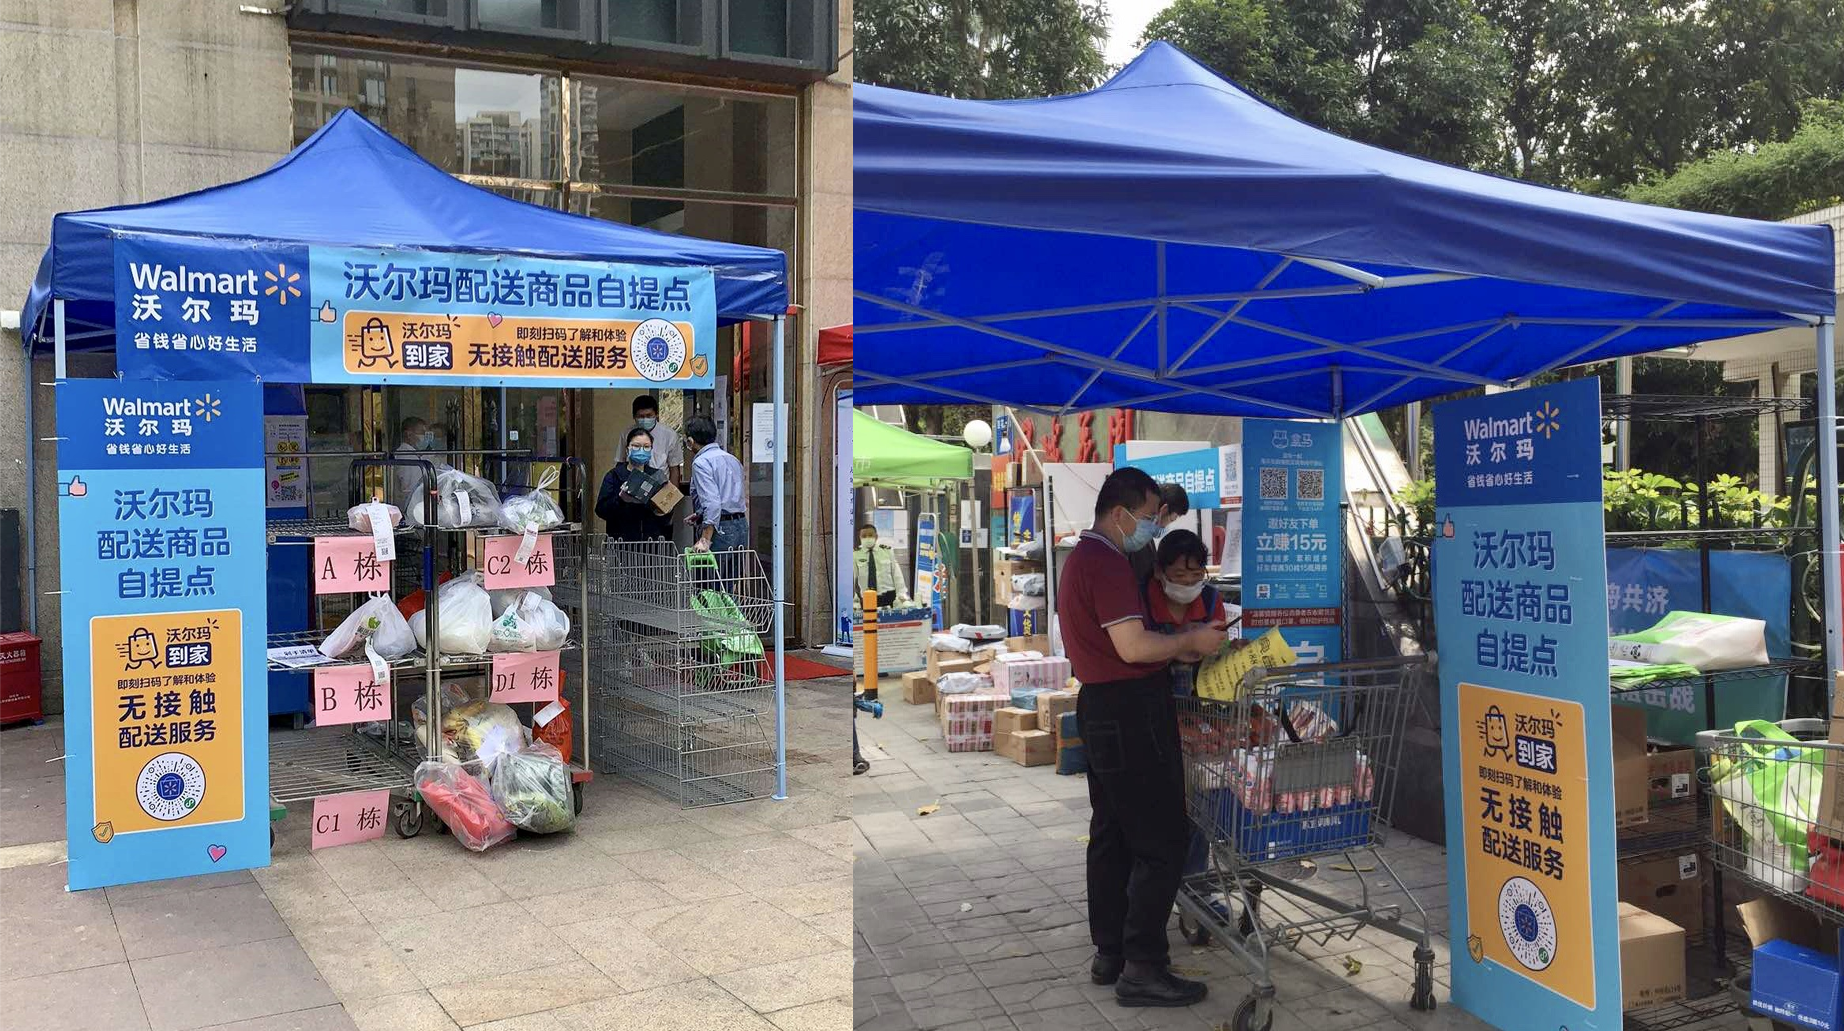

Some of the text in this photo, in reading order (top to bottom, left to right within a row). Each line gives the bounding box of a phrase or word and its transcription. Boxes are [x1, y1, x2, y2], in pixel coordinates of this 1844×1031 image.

[130, 262, 258, 296] Walmart
[343, 261, 692, 313] 沃尔玛配送商品自提点
[132, 294, 260, 326] 沃尔玛
[134, 332, 258, 353] 省钱省心好生活
[402, 322, 452, 340] 沃尔玛
[516, 326, 627, 342] 即刻扫码了解和体验
[404, 343, 452, 369] 到家
[468, 343, 629, 370] 无接触配送服务
[103, 397, 191, 417] Walmart
[104, 418, 193, 436] 沃尔玛
[1464, 411, 1533, 441] Walmart
[106, 443, 191, 456] 省钱省心好生活
[1466, 439, 1534, 465] 沃尔玛
[1467, 471, 1533, 488] 省钱省心好生活
[114, 489, 214, 521] 沃尔玛
[97, 527, 231, 561] 配送商品
[1256, 533, 1327, 551] 立赚15元
[1473, 529, 1555, 570] 沃尔玛
[321, 551, 383, 582] A 栋
[487, 550, 549, 576] C2 栋
[118, 566, 217, 599] 自提点
[1461, 579, 1572, 625] 配送商品
[166, 626, 211, 643] 沃尔玛
[168, 645, 210, 666] 到家
[1477, 628, 1558, 678] 自提点
[117, 673, 216, 690] 即刻扫码了解和体验
[495, 665, 553, 693] D1 栋
[118, 688, 217, 722] 无接触
[321, 680, 383, 712] B 栋
[119, 719, 217, 749] 配送服务
[1515, 713, 1555, 738] 沃尔玛
[1517, 740, 1555, 770] 到家
[1479, 766, 1562, 800] 即刻扫码了解和体验
[316, 806, 381, 834] C1 栋
[1480, 787, 1564, 845] 无接触
[1482, 826, 1565, 880] 配送服务
